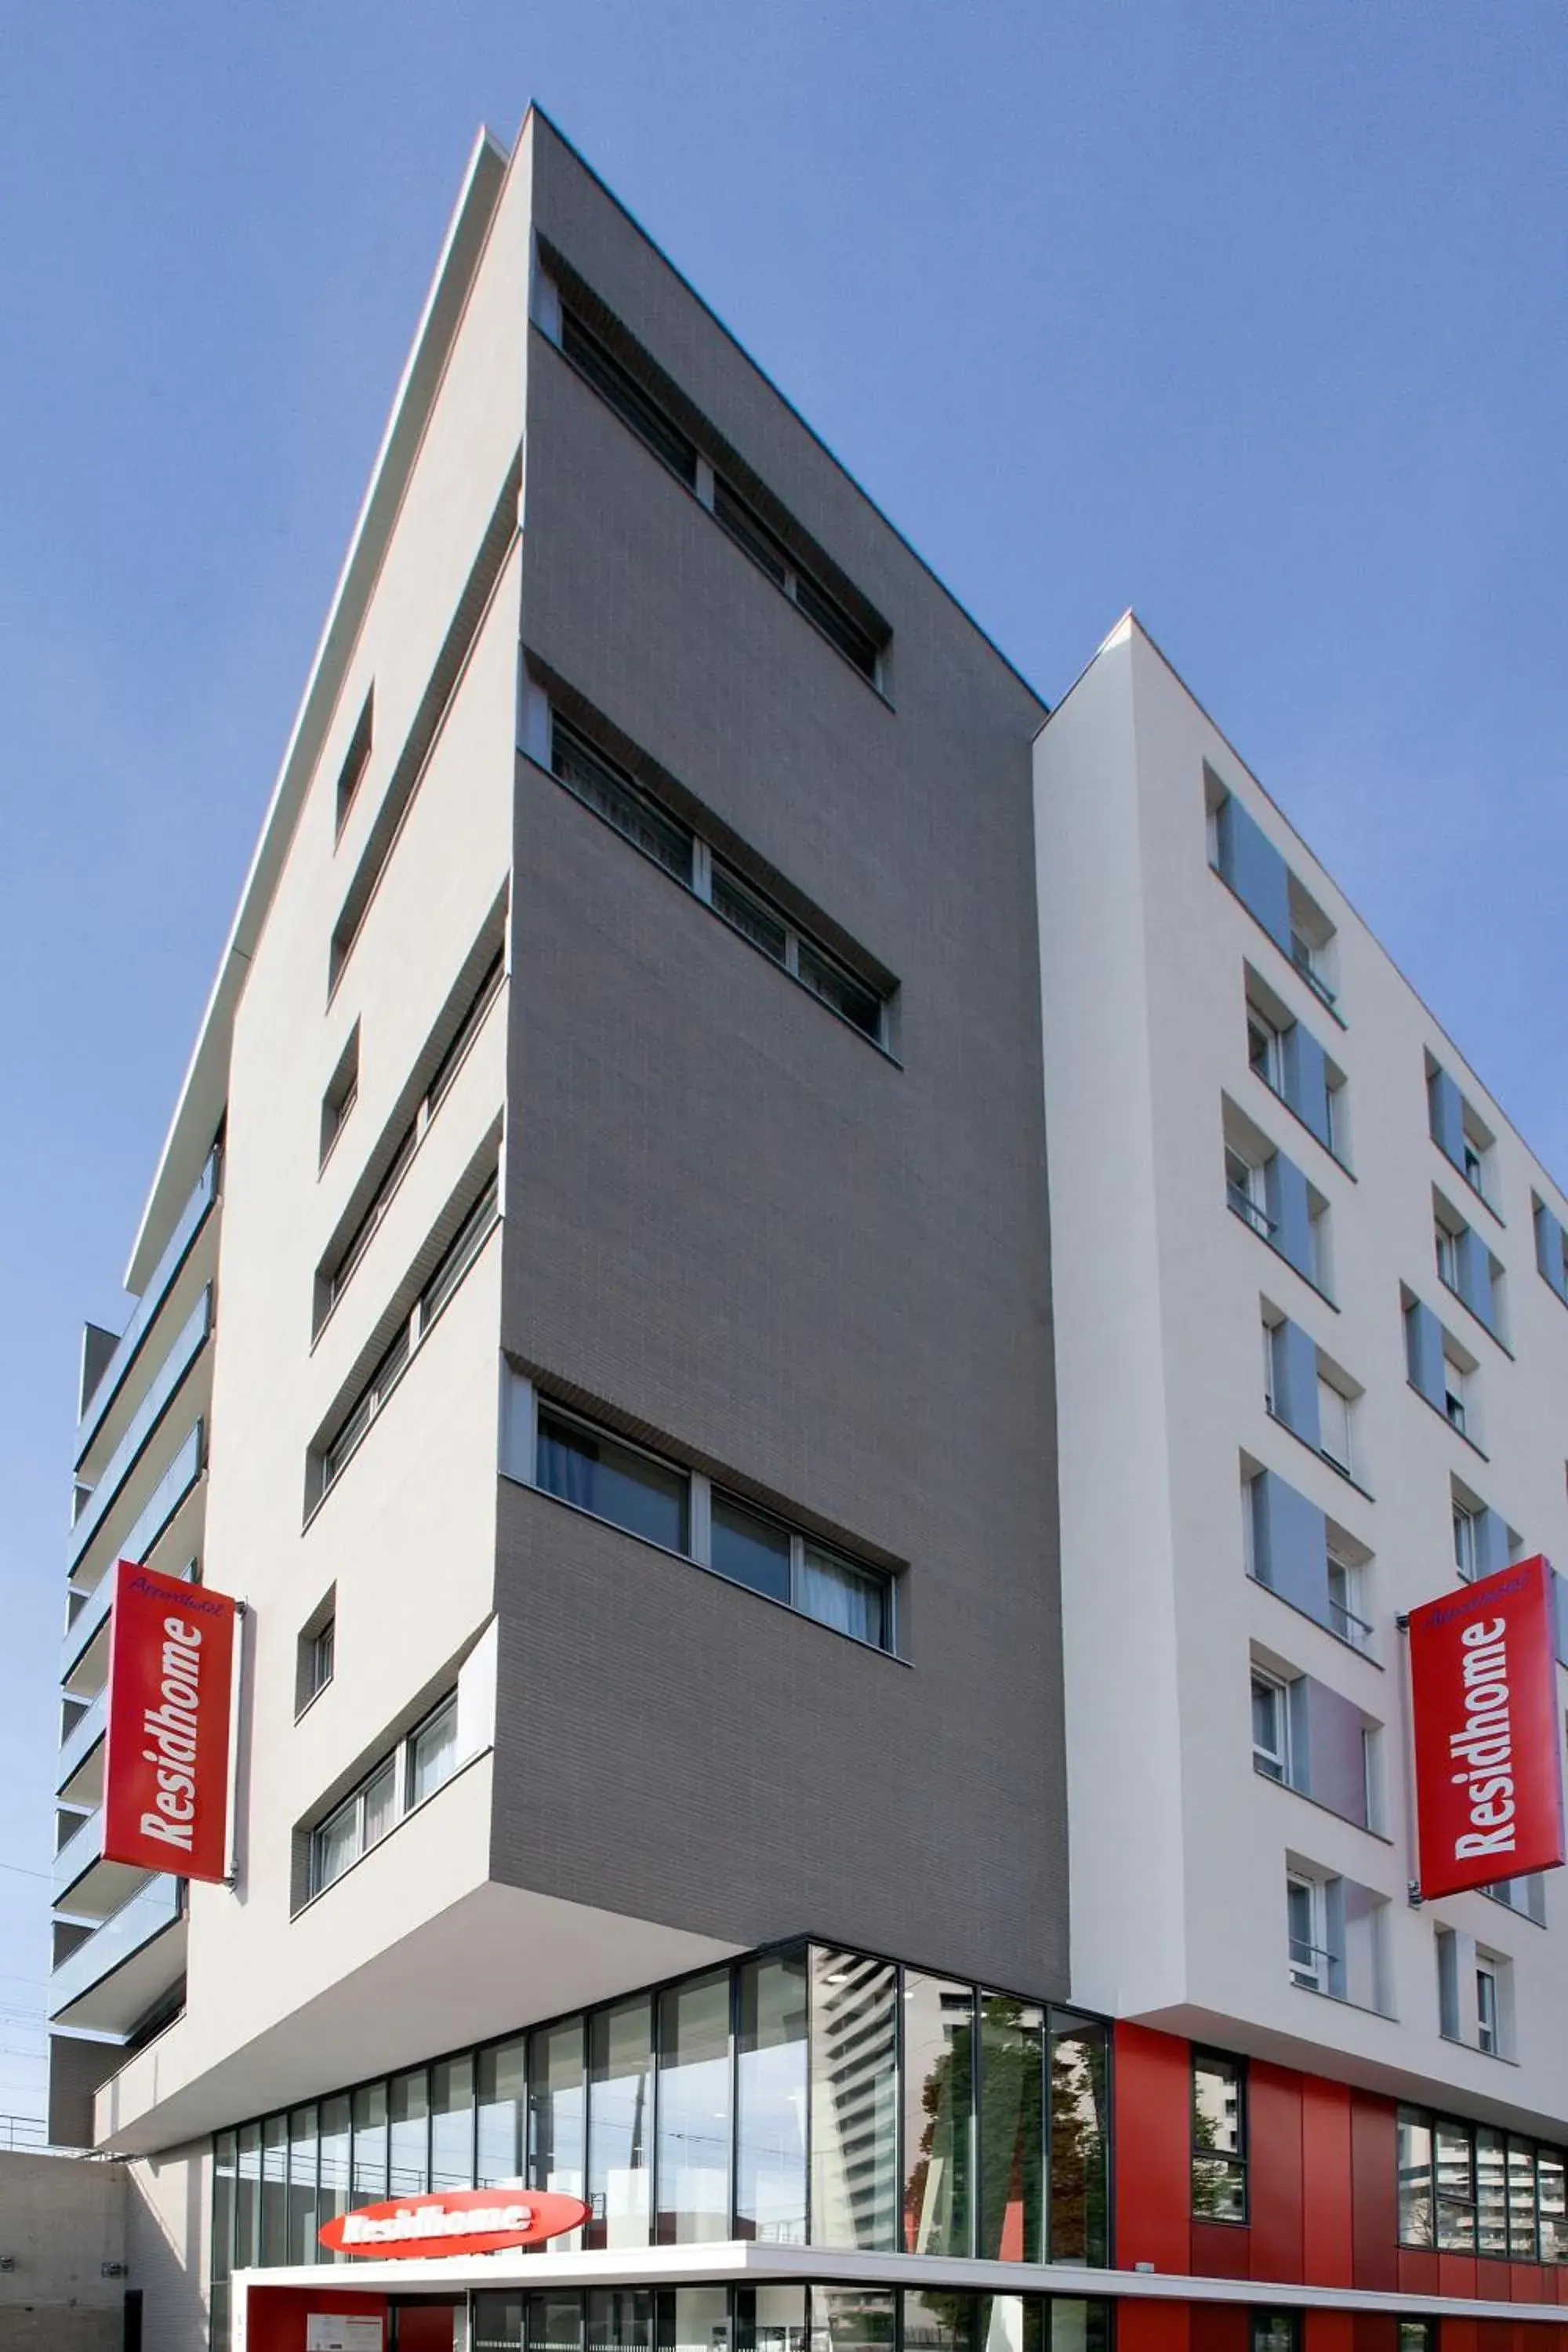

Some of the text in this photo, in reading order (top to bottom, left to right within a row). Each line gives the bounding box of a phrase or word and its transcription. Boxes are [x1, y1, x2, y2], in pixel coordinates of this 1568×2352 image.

[140, 1617, 202, 1853] Residhome
[1450, 1617, 1515, 1860] Residhome
[342, 2205, 532, 2244] Residhome
